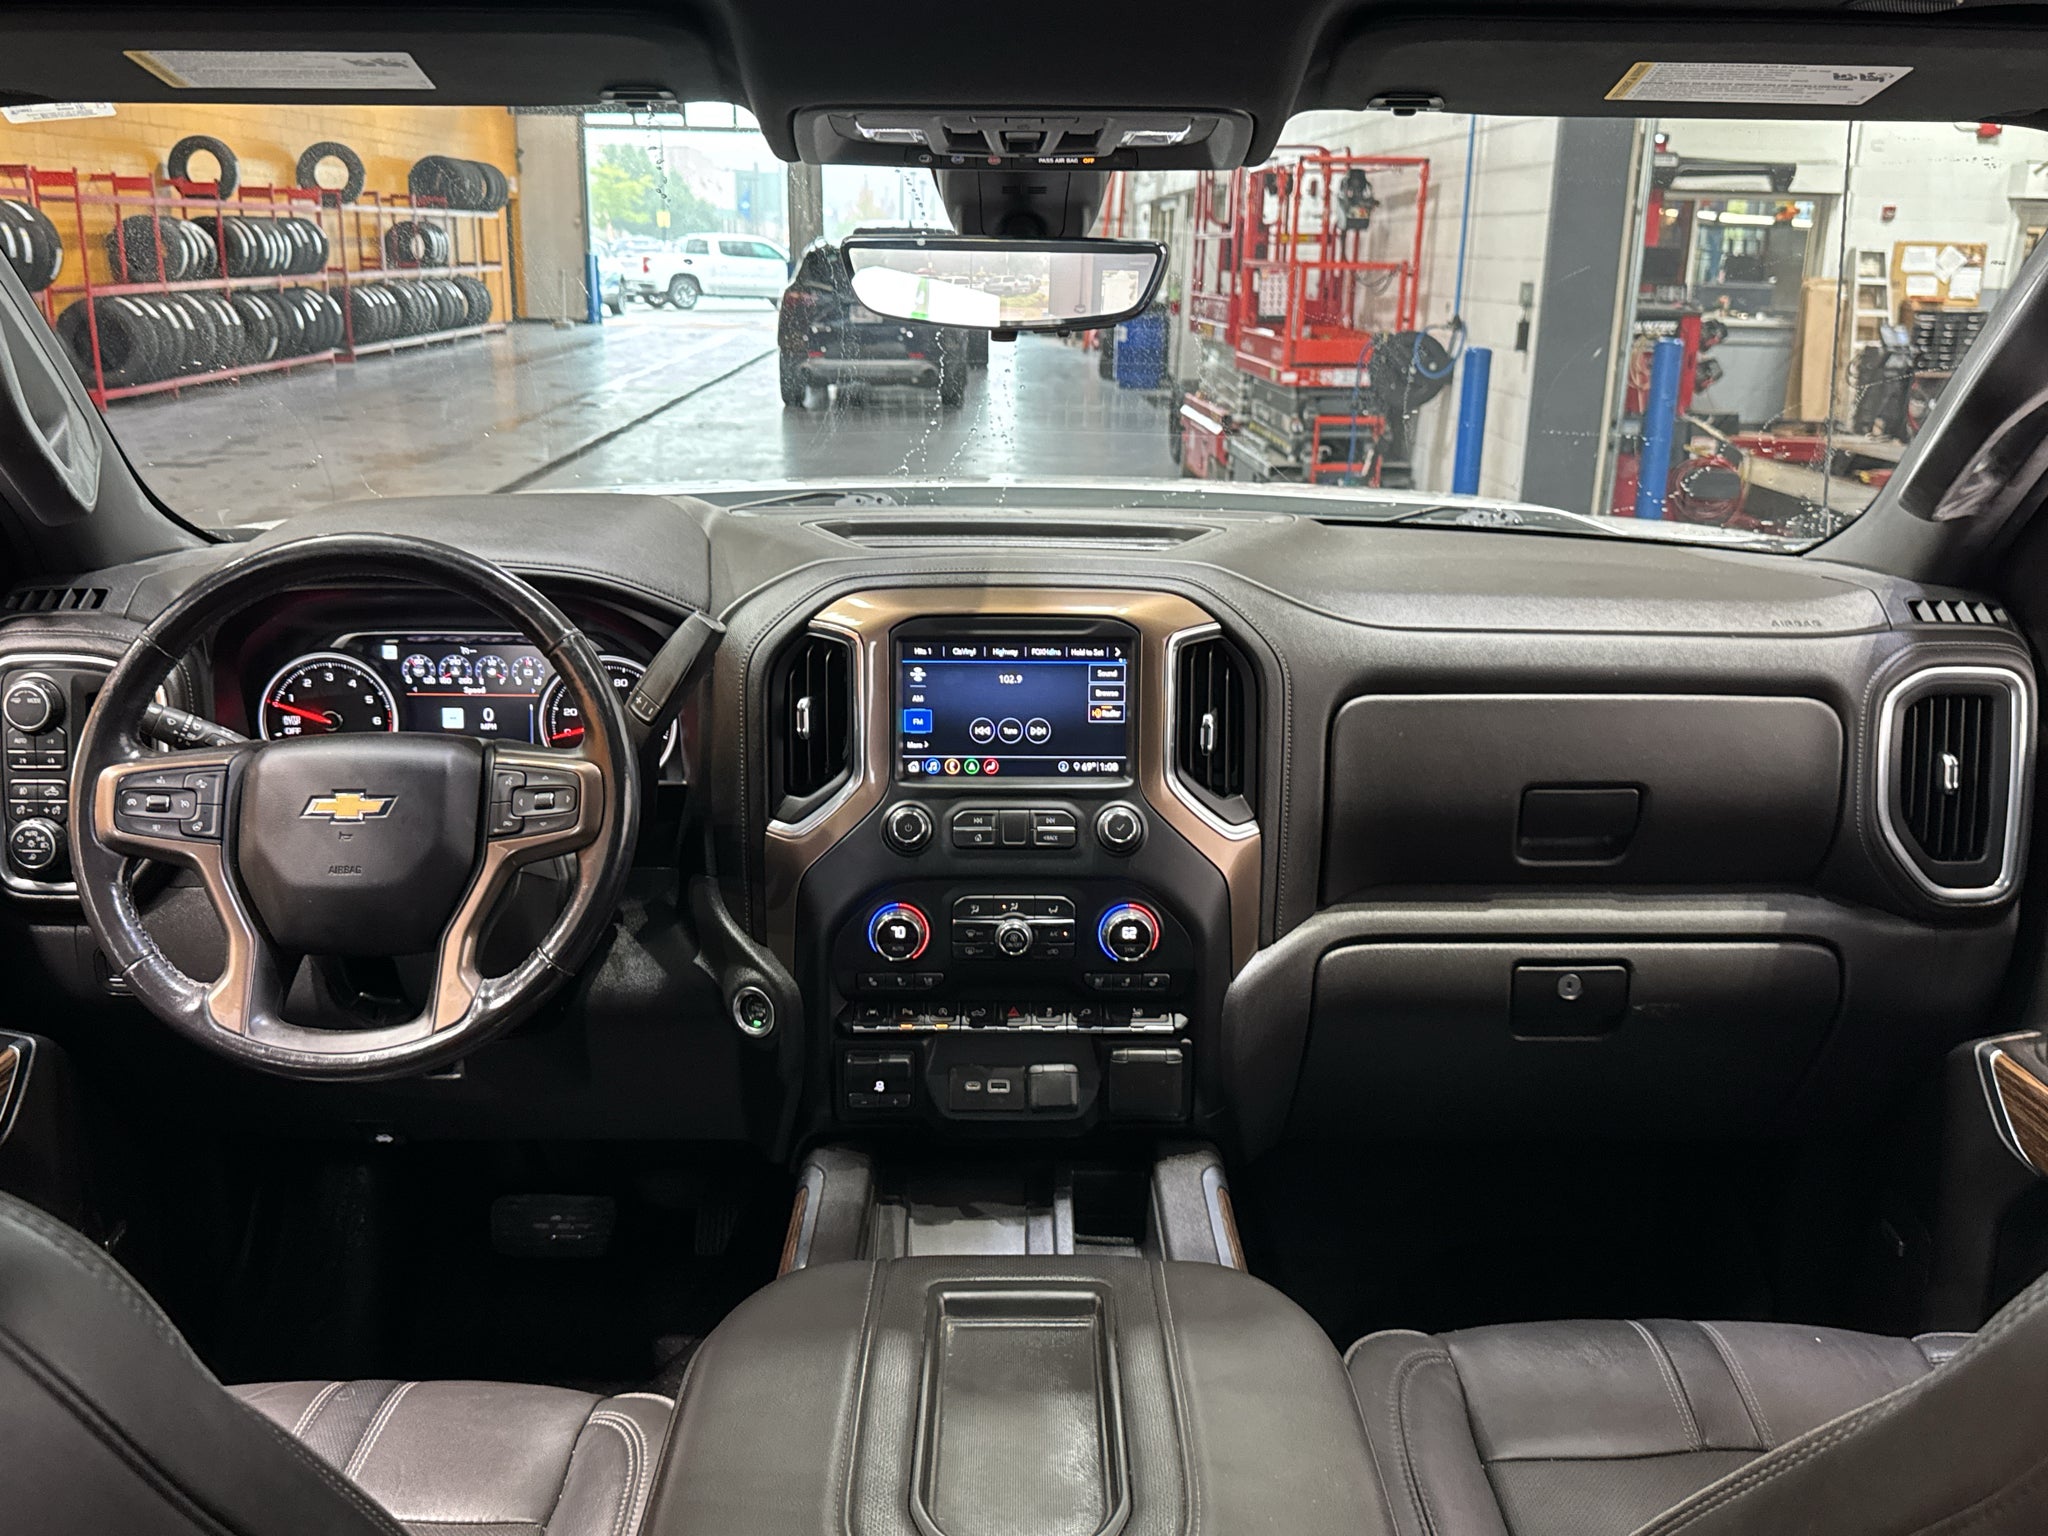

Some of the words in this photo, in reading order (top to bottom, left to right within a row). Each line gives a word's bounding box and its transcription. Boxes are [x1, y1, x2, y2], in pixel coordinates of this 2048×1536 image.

[992, 647, 1018, 658] Highway
[1070, 648, 1085, 656] Hold
[1086, 648, 1093, 656] to
[1093, 648, 1104, 656] Set
[324, 672, 334, 682] 3
[1097, 669, 1118, 678] Sound
[302, 678, 312, 688] 2
[347, 679, 357, 688] 4
[613, 678, 629, 688] 80
[998, 674, 1023, 684] 102.9
[1095, 689, 1119, 697] Browse
[288, 693, 295, 703] 1
[364, 695, 374, 704] 5
[911, 694, 925, 703] AM
[482, 707, 495, 722] 0
[563, 707, 578, 717] 20
[371, 716, 382, 726] 6
[912, 718, 924, 726] FM
[284, 727, 302, 735] OFF
[480, 722, 498, 731] MPH
[1002, 727, 1019, 736] Tune
[906, 741, 923, 749] More
[328, 865, 362, 875] AIRBAG
[890, 925, 906, 939] 70
